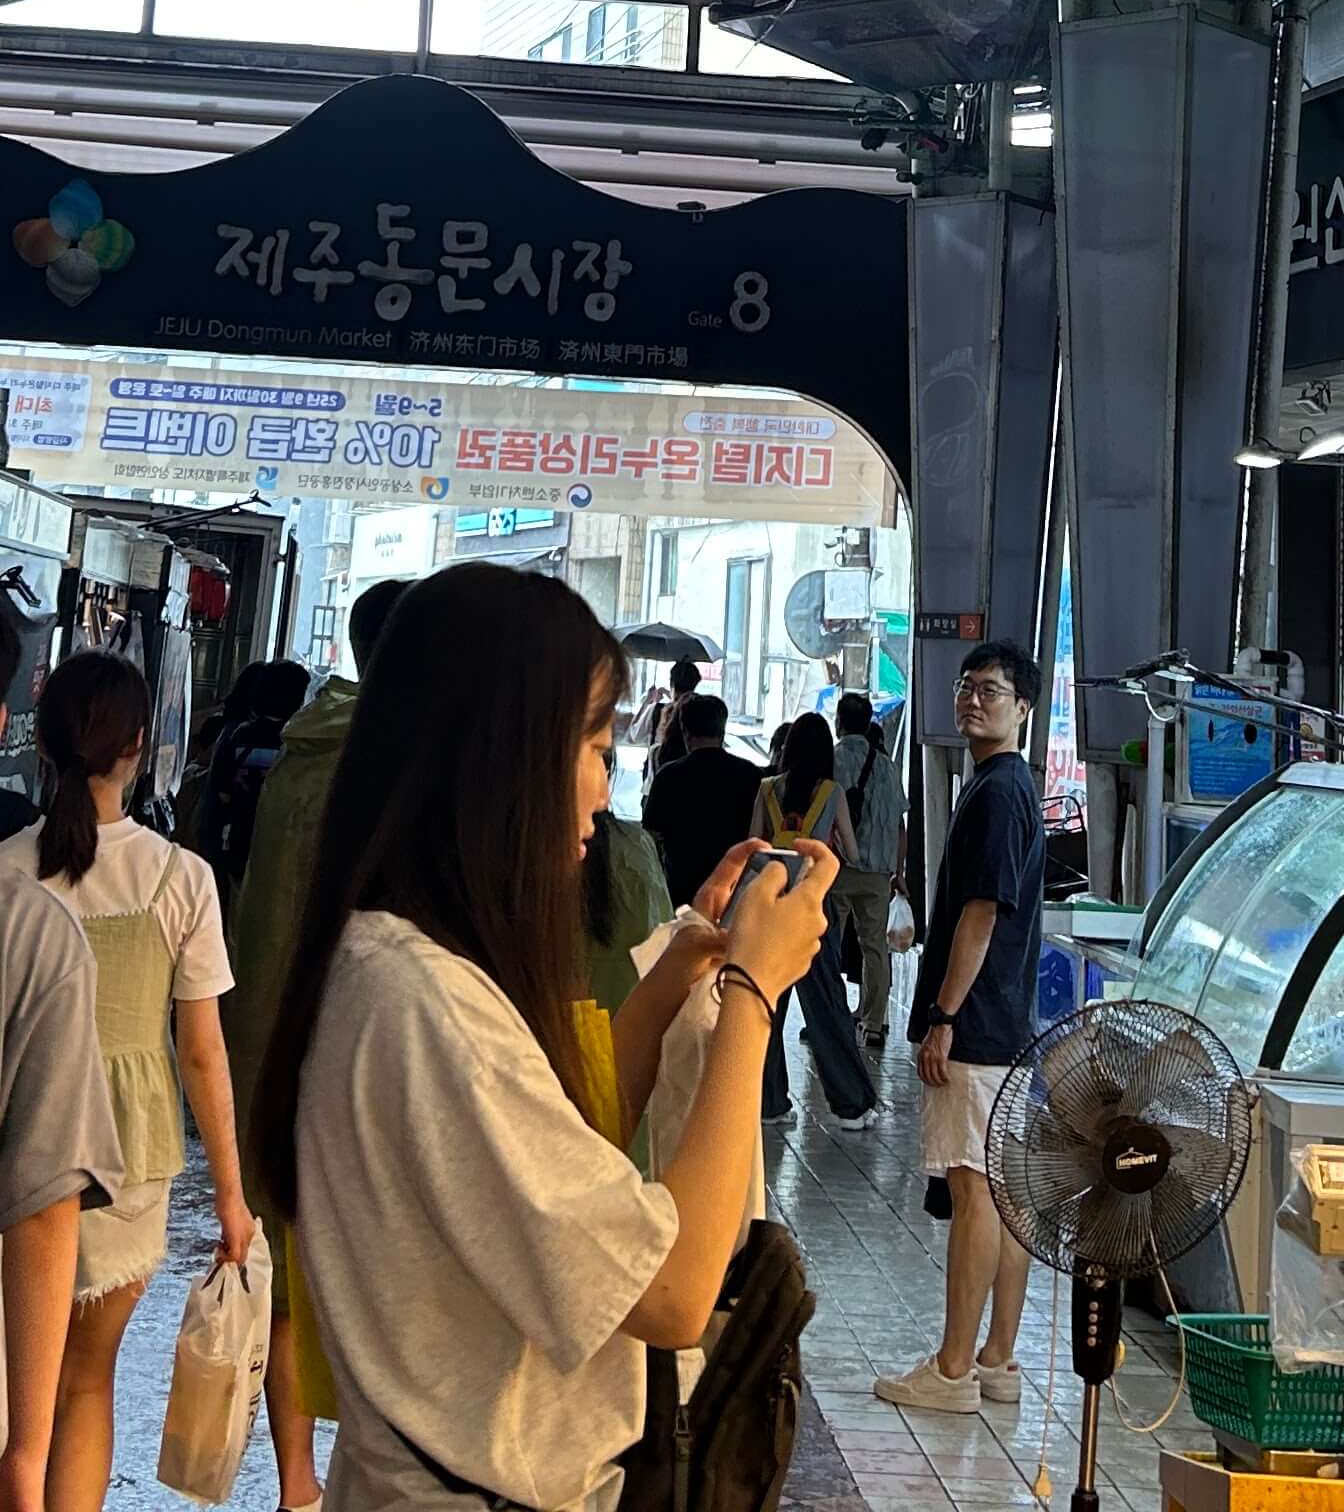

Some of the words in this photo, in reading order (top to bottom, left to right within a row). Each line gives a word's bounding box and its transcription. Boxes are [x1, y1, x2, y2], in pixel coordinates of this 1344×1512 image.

[215, 203, 633, 322] 제주동문시장
[154, 315, 201, 337] JEJU
[208, 319, 312, 346] Dongmun
[319, 326, 393, 348] Market
[688, 311, 722, 329] Gate
[729, 271, 771, 333] 8
